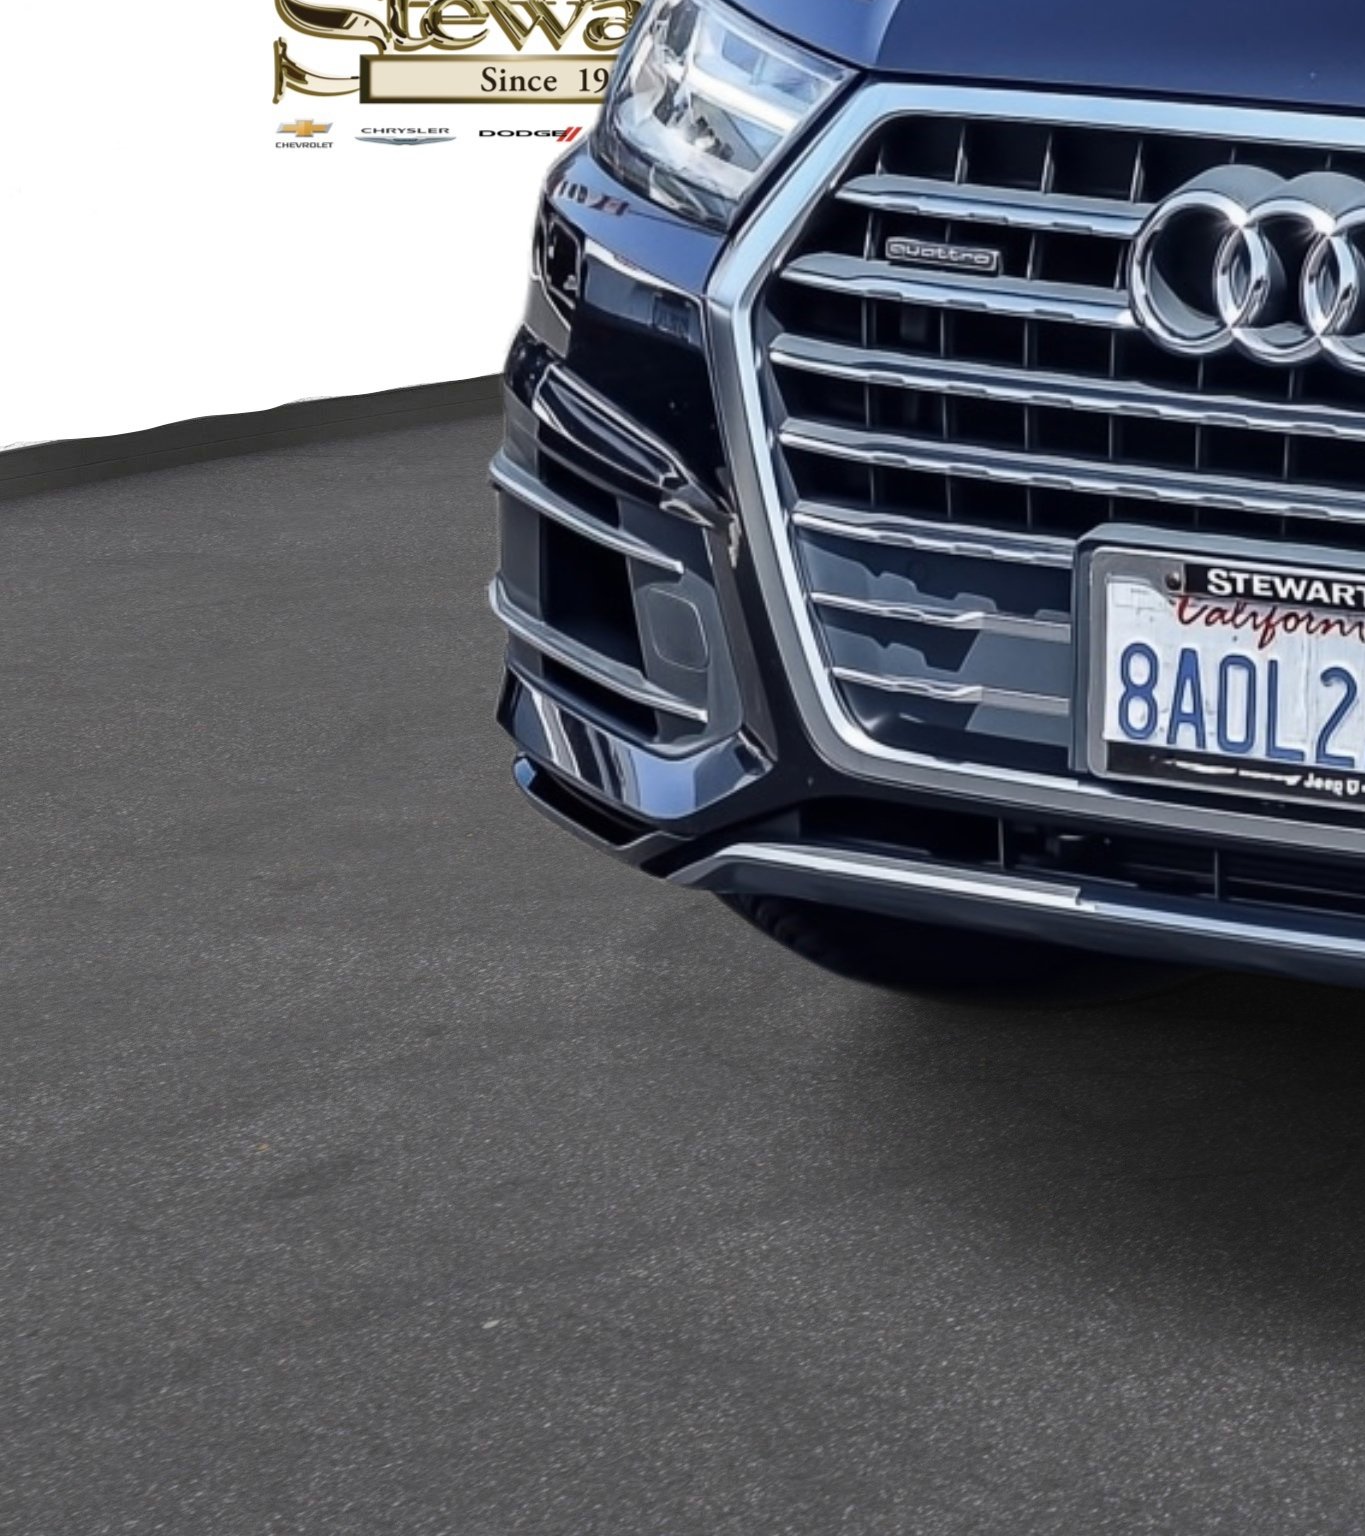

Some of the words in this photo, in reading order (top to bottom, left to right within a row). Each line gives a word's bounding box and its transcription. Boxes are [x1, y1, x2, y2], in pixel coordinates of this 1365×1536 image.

[481, 66, 557, 92] Since
[579, 67, 610, 94] 19
[479, 128, 567, 137] DODGE
